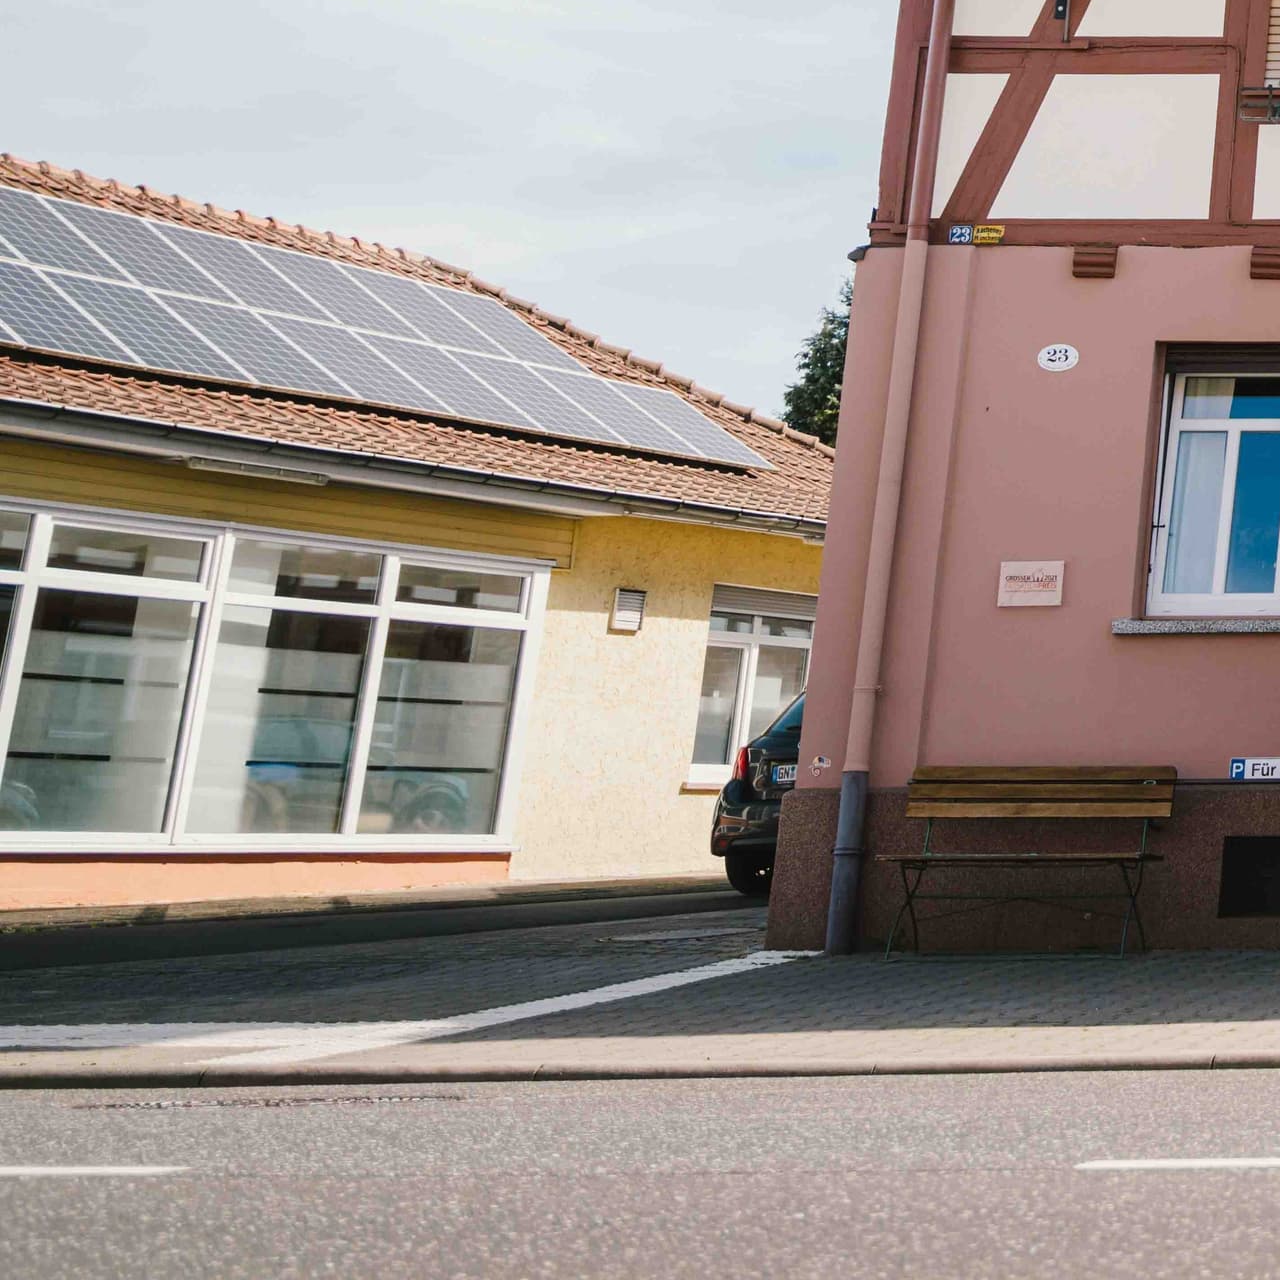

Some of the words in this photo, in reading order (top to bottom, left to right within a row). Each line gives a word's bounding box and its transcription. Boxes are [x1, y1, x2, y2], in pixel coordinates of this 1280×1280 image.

[952, 227, 970, 242] 23
[1047, 348, 1068, 362] 23
[1232, 762, 1244, 778] P
[1251, 762, 1277, 777] Für
